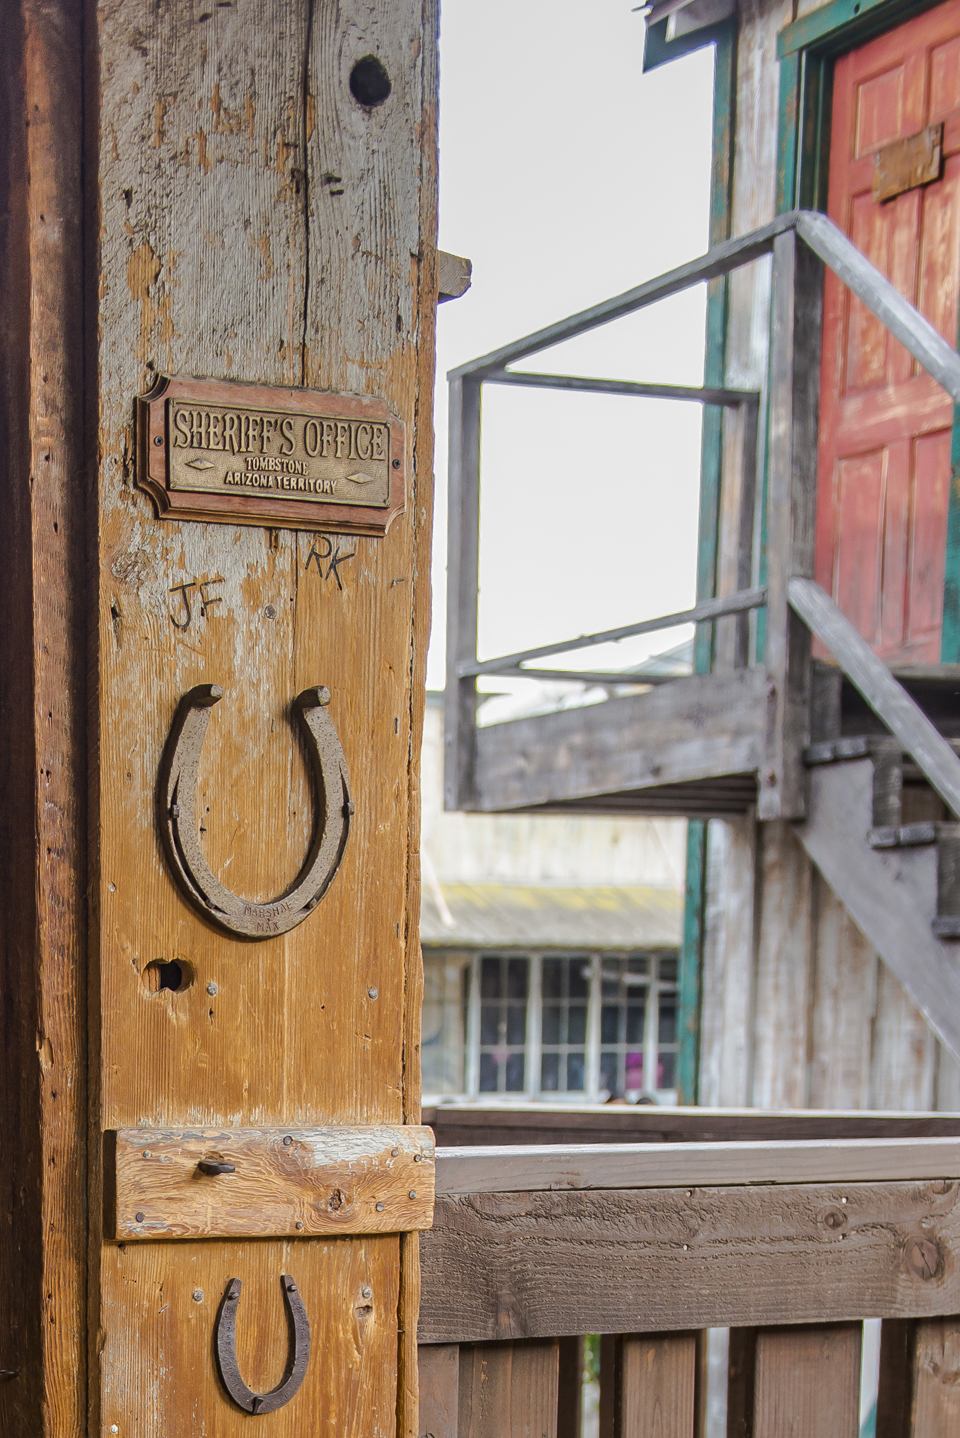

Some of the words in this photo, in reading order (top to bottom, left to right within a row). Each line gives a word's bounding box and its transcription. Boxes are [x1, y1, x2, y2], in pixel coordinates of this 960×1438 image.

[173, 408, 295, 455] SHERIFF'S
[304, 418, 386, 461] OFFICE
[224, 470, 273, 488] ARIZONA
[276, 475, 338, 495] TERRITORY
[246, 456, 309, 476] TOMBSTONE
[169, 577, 226, 633] JF
